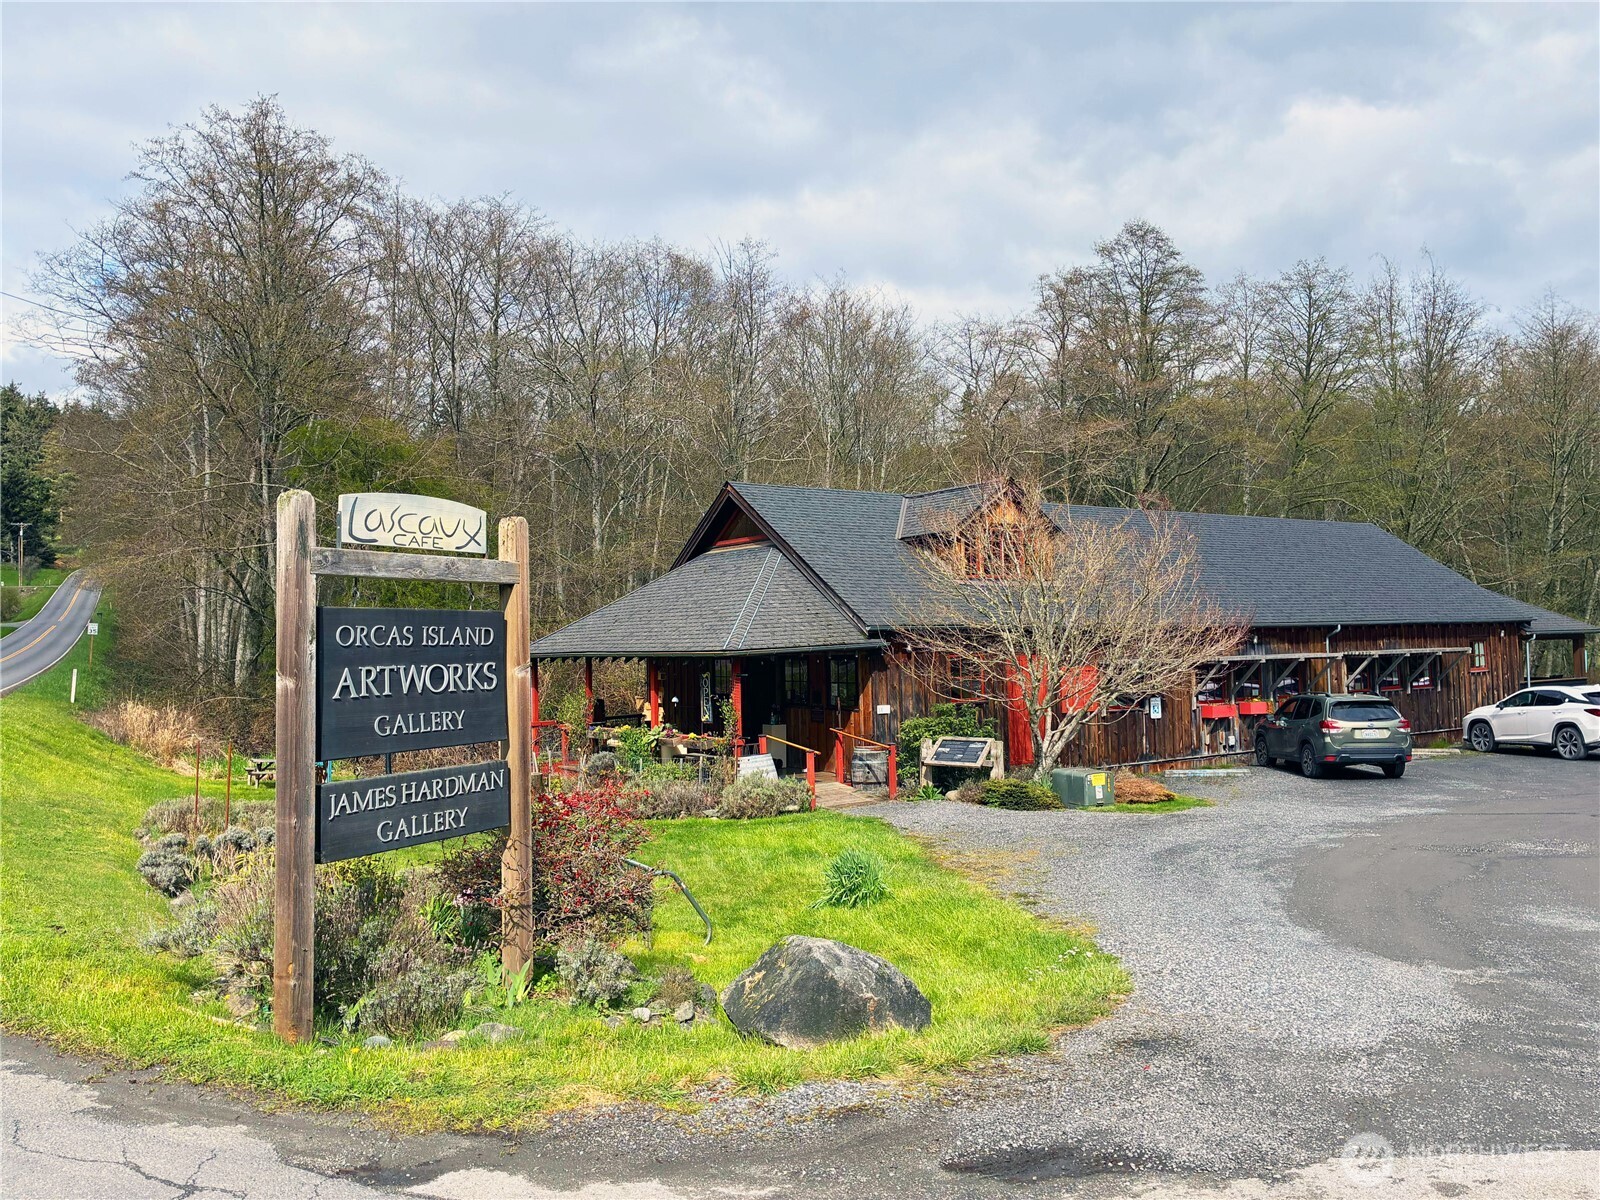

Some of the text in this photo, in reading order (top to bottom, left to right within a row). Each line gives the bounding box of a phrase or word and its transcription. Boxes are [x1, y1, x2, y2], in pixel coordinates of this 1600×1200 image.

[392, 533, 444, 550] CAFE
[335, 624, 495, 647] ORCAS ISLAND
[332, 661, 498, 700] ARTWORKS
[702, 678, 710, 717] OPEN
[373, 709, 466, 737] GALLERY
[328, 769, 505, 820] JAMES HARDMAN
[376, 806, 469, 843] GALLERY
